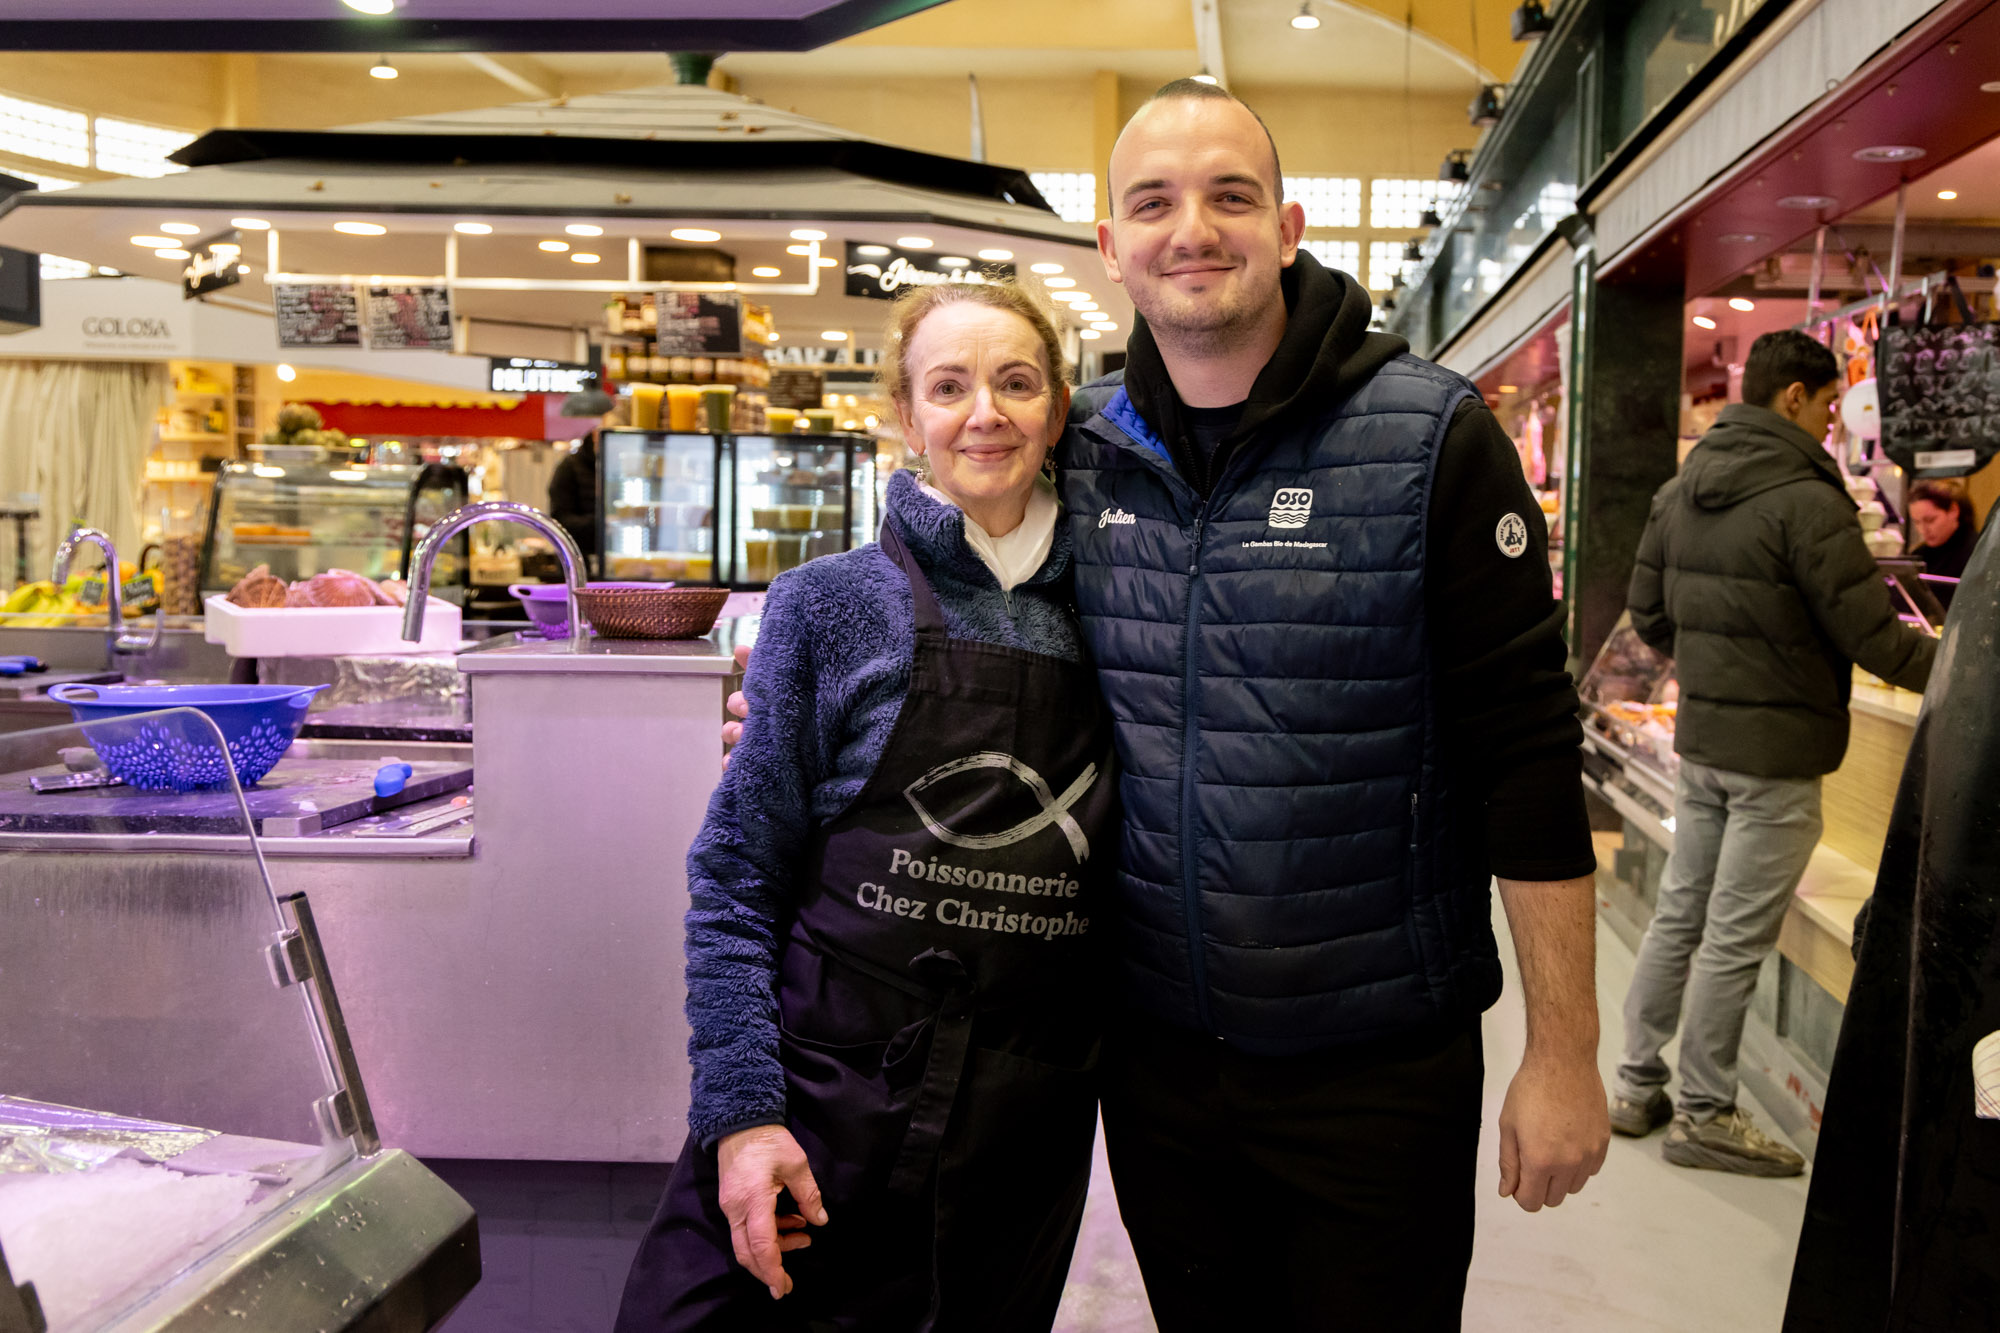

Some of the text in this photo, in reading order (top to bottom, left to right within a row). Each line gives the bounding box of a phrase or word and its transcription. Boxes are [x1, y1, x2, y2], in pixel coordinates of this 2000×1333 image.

[82, 317, 171, 338] GOLOSA
[1276, 491, 1311, 506] OSO
[1098, 507, 1137, 529] Julien
[1250, 540, 1273, 548] Gambas
[1273, 540, 1284, 548] Bio
[1284, 540, 1293, 548] de
[1293, 541, 1329, 550] Madagascar
[889, 848, 1080, 898] Poissonnerie
[857, 882, 1090, 941] Chez Christophe
